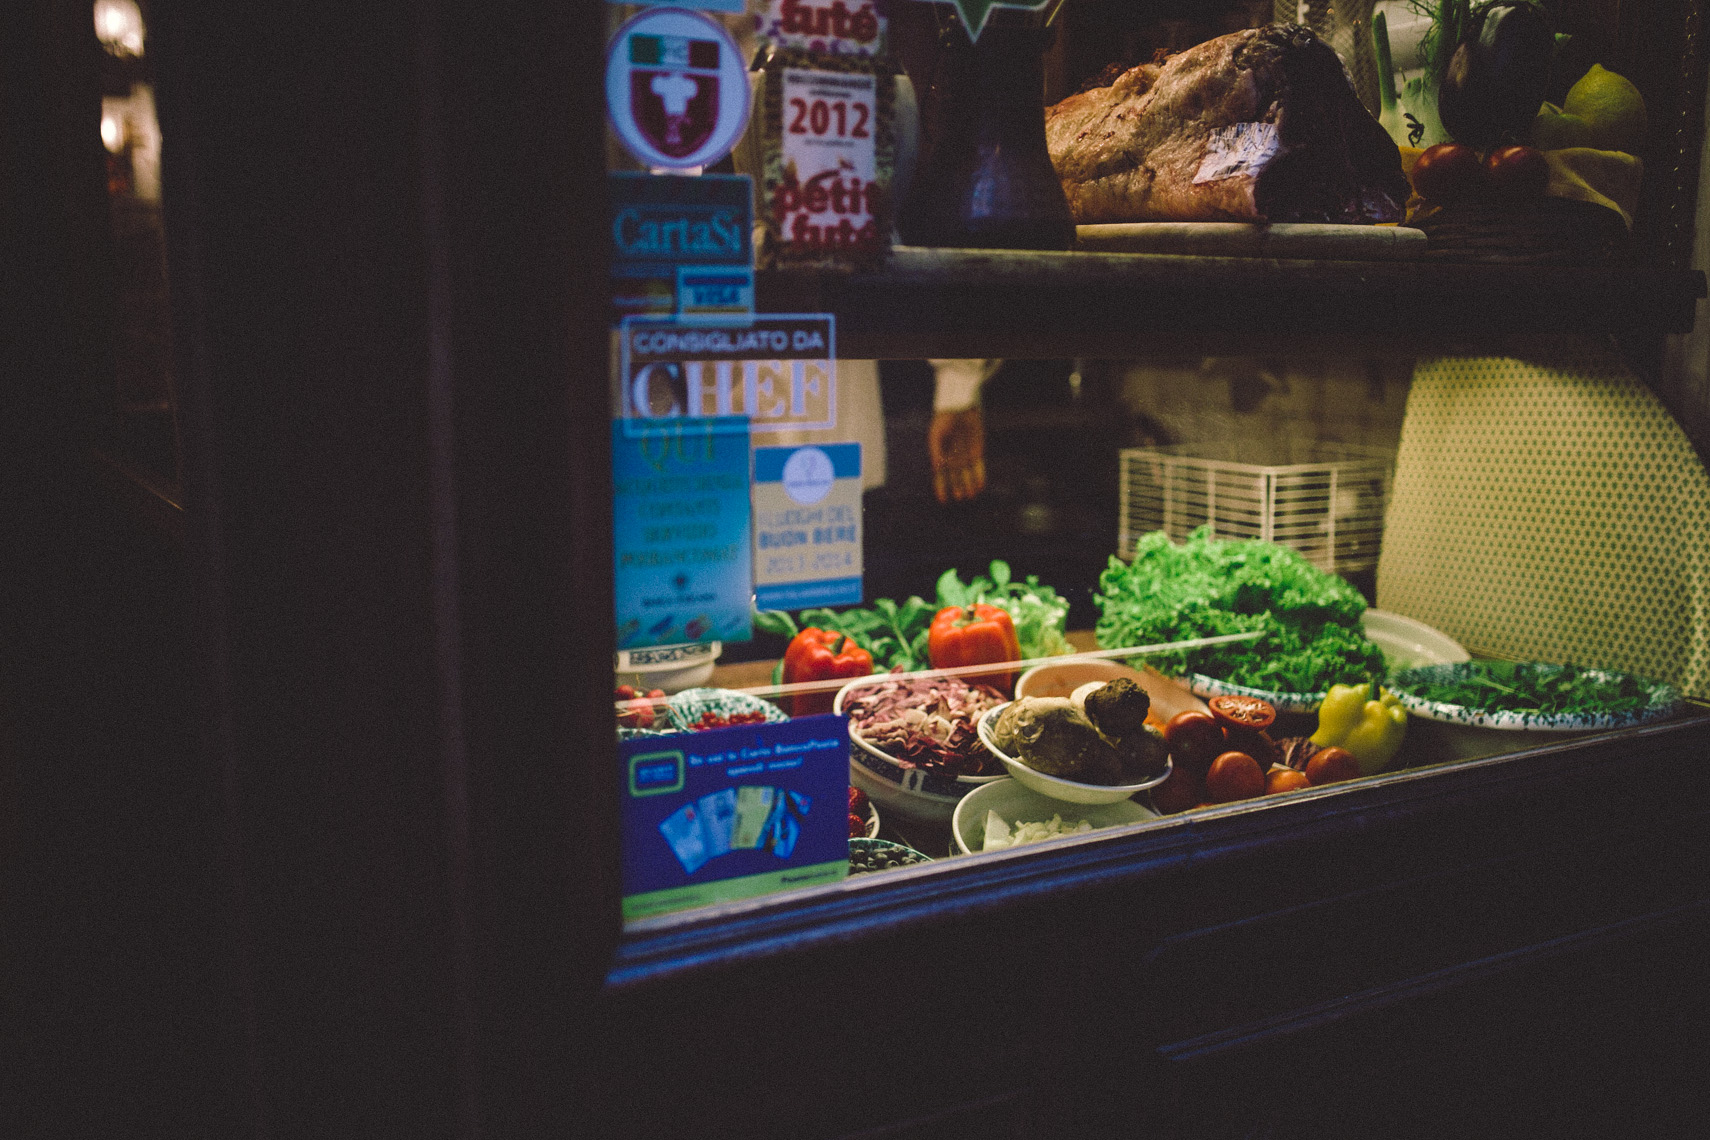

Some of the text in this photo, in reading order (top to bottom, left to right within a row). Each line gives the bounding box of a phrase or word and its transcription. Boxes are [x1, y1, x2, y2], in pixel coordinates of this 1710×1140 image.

[789, 97, 870, 139] 2012
[694, 286, 740, 304] VISA
[633, 330, 824, 353] CONSIGLIATO DA
[632, 360, 830, 419] CHEF
[759, 525, 856, 550] BUON BERE
